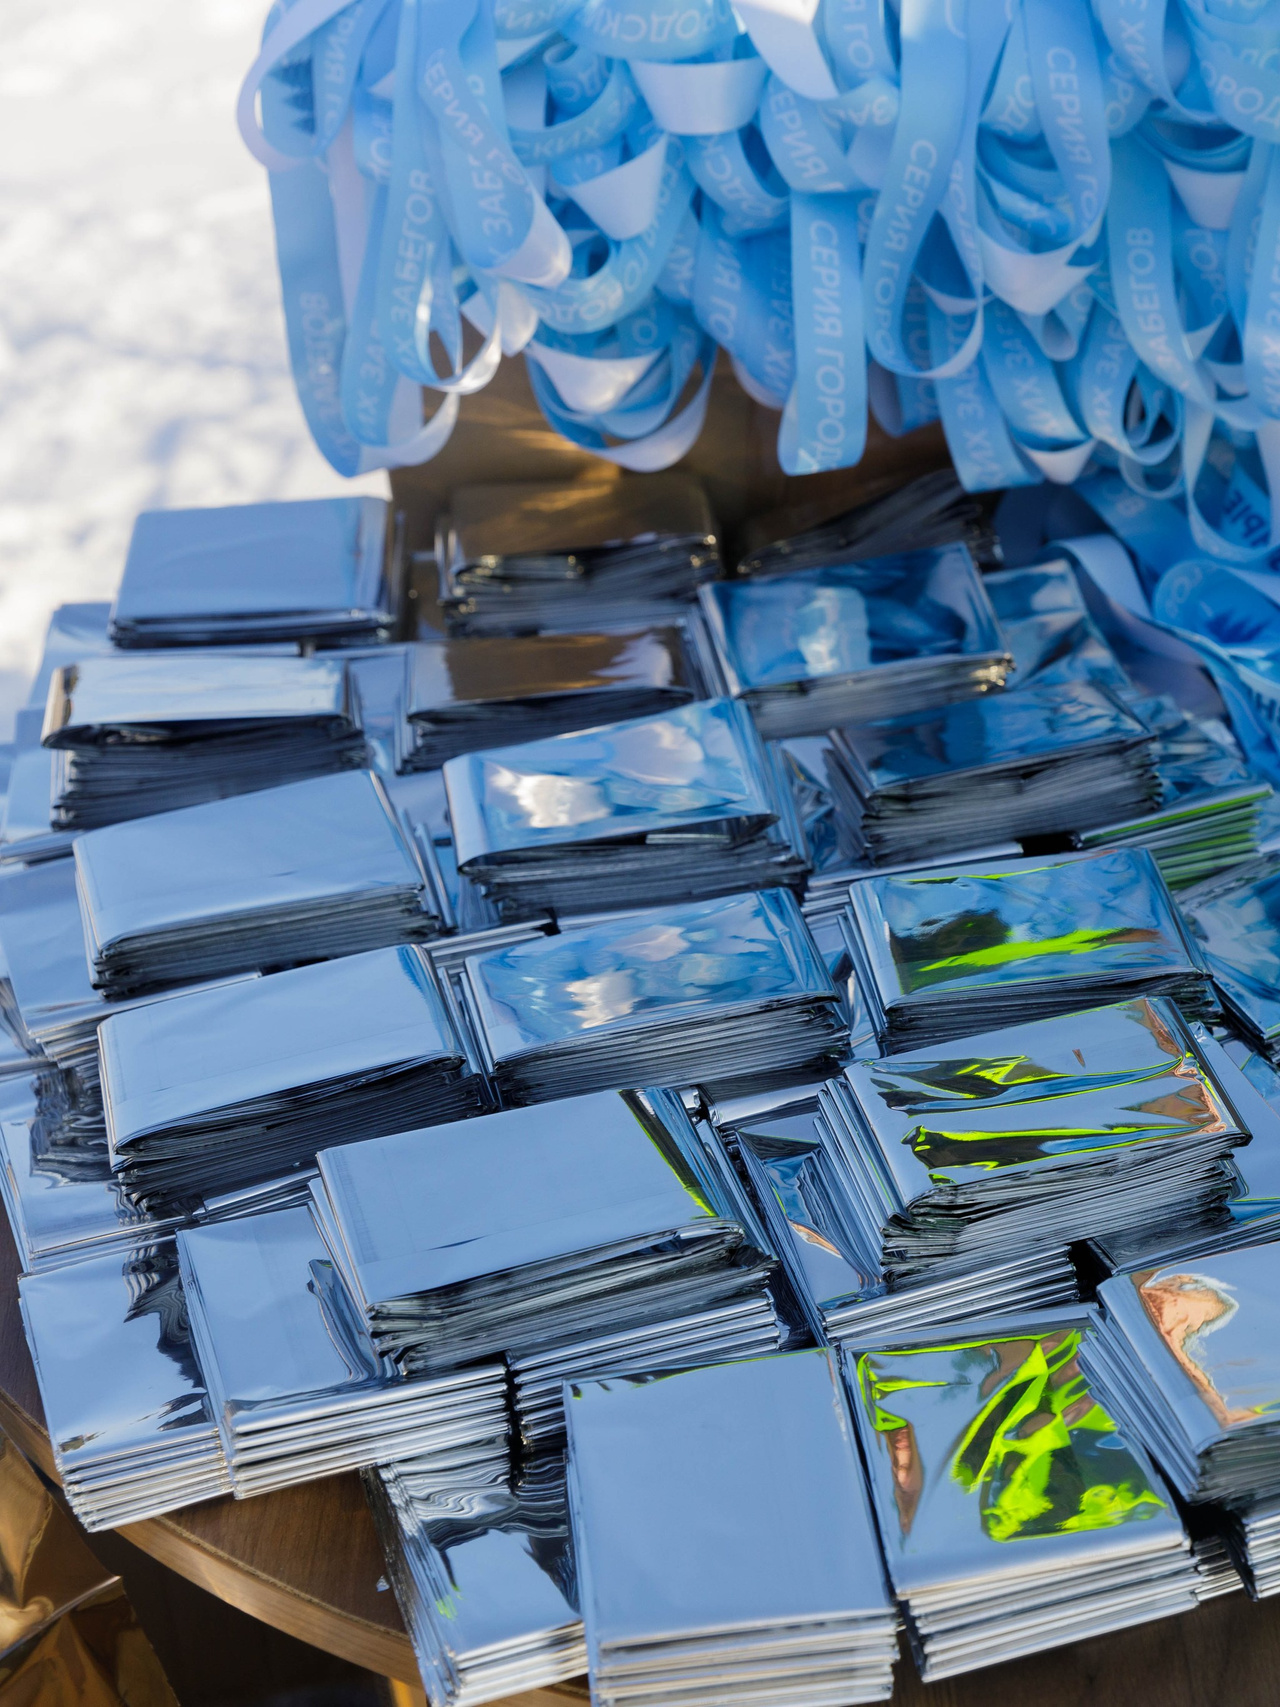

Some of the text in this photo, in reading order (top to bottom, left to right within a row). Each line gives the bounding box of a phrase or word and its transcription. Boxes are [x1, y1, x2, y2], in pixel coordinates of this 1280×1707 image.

[770, 91, 828, 178] ЕРИЯ
[1047, 47, 1093, 165] СЕРИЯ
[884, 139, 937, 251] СЕРИЯ
[810, 219, 846, 470] СЕРИЯ ГОРОД
